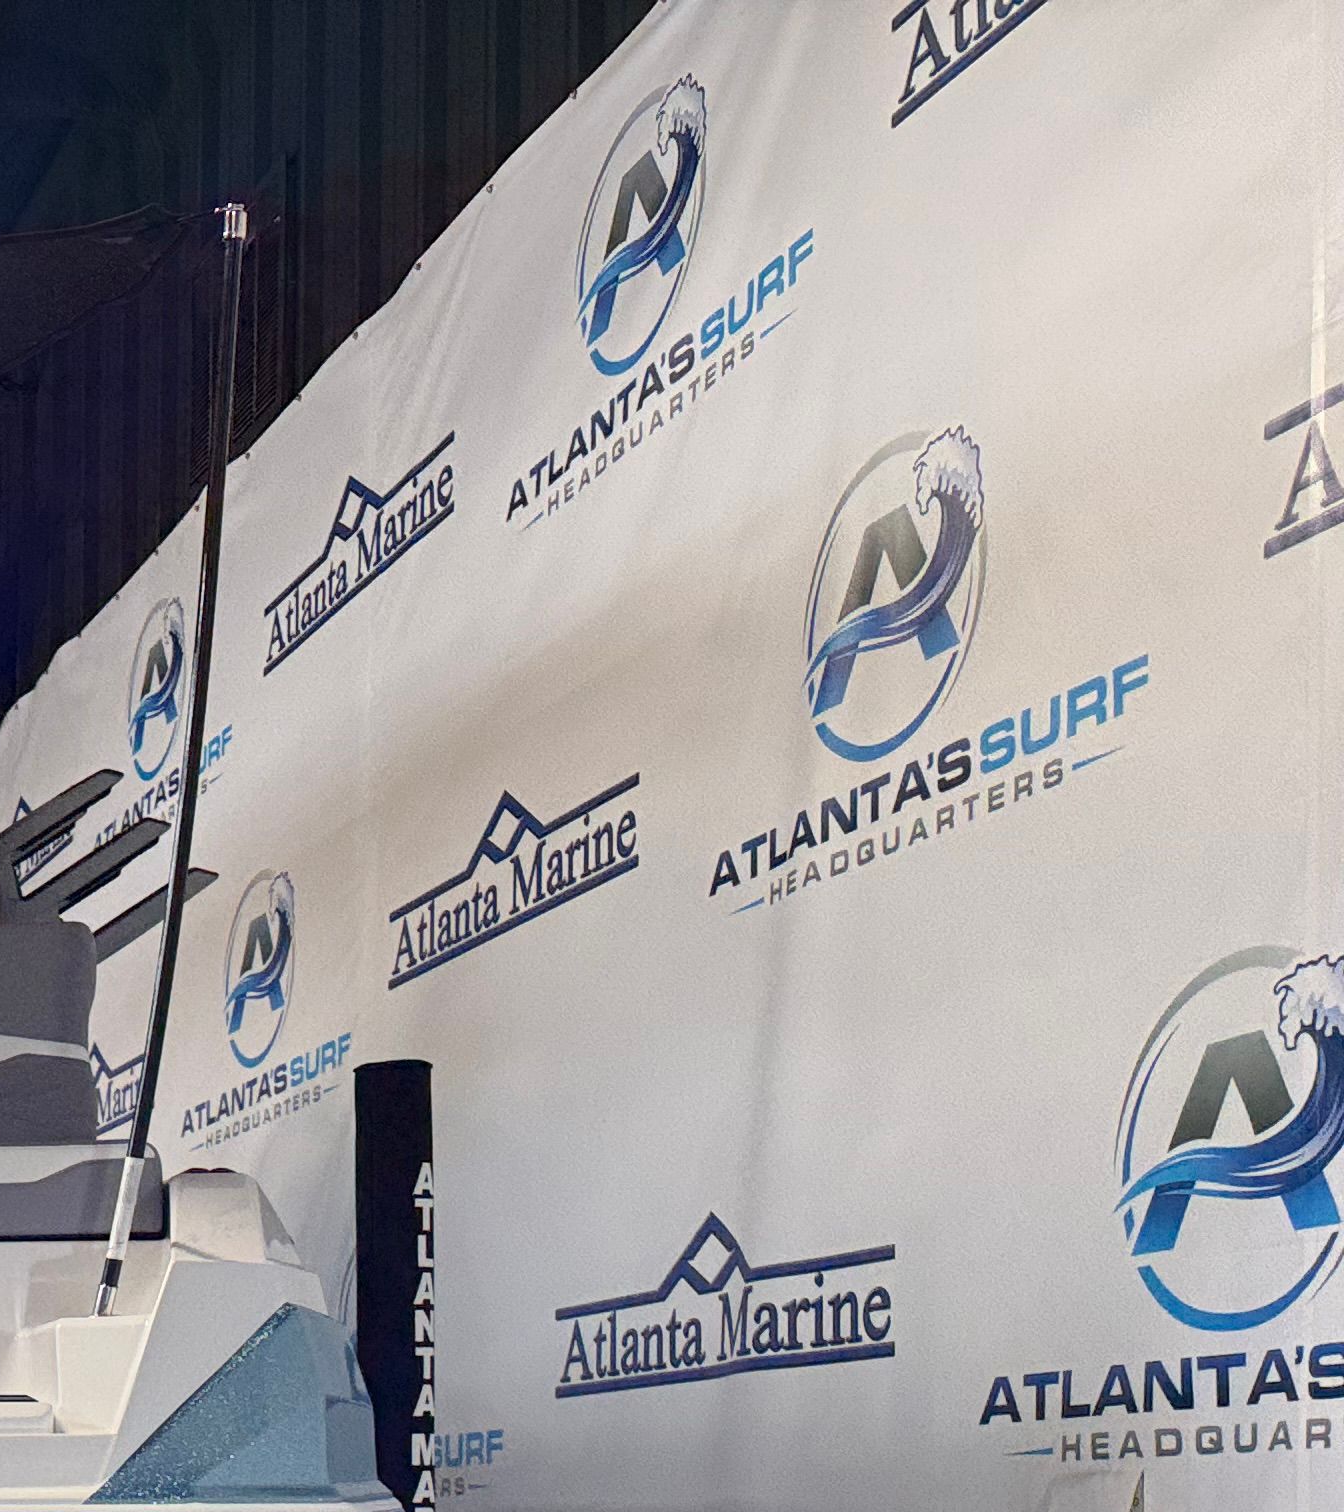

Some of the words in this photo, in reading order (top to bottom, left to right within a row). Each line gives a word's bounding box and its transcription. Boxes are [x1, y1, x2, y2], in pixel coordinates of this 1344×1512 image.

[506, 333, 695, 523] ATLANTA'S
[700, 228, 814, 362] SURF
[547, 332, 756, 515] HEADQUARTERS
[265, 563, 348, 664] Atlanta
[354, 461, 454, 583] Marine
[709, 737, 972, 897] ATLANTA'S
[979, 653, 1149, 774] SURF
[768, 756, 1064, 906] HEADQUARTERS
[392, 871, 501, 976] Atlanta
[508, 808, 638, 935] Marine
[180, 1062, 288, 1138] ATLANTA'S
[289, 1031, 352, 1088] SURF
[204, 1084, 322, 1150] HEADQUARTERS
[412, 1161, 435, 1418] ATLANTA
[560, 1305, 706, 1384] Atlanta
[716, 1271, 893, 1362] Marine
[978, 1341, 1344, 1426] ATLANTA'S
[1060, 1417, 1333, 1464] HEADQUAR
